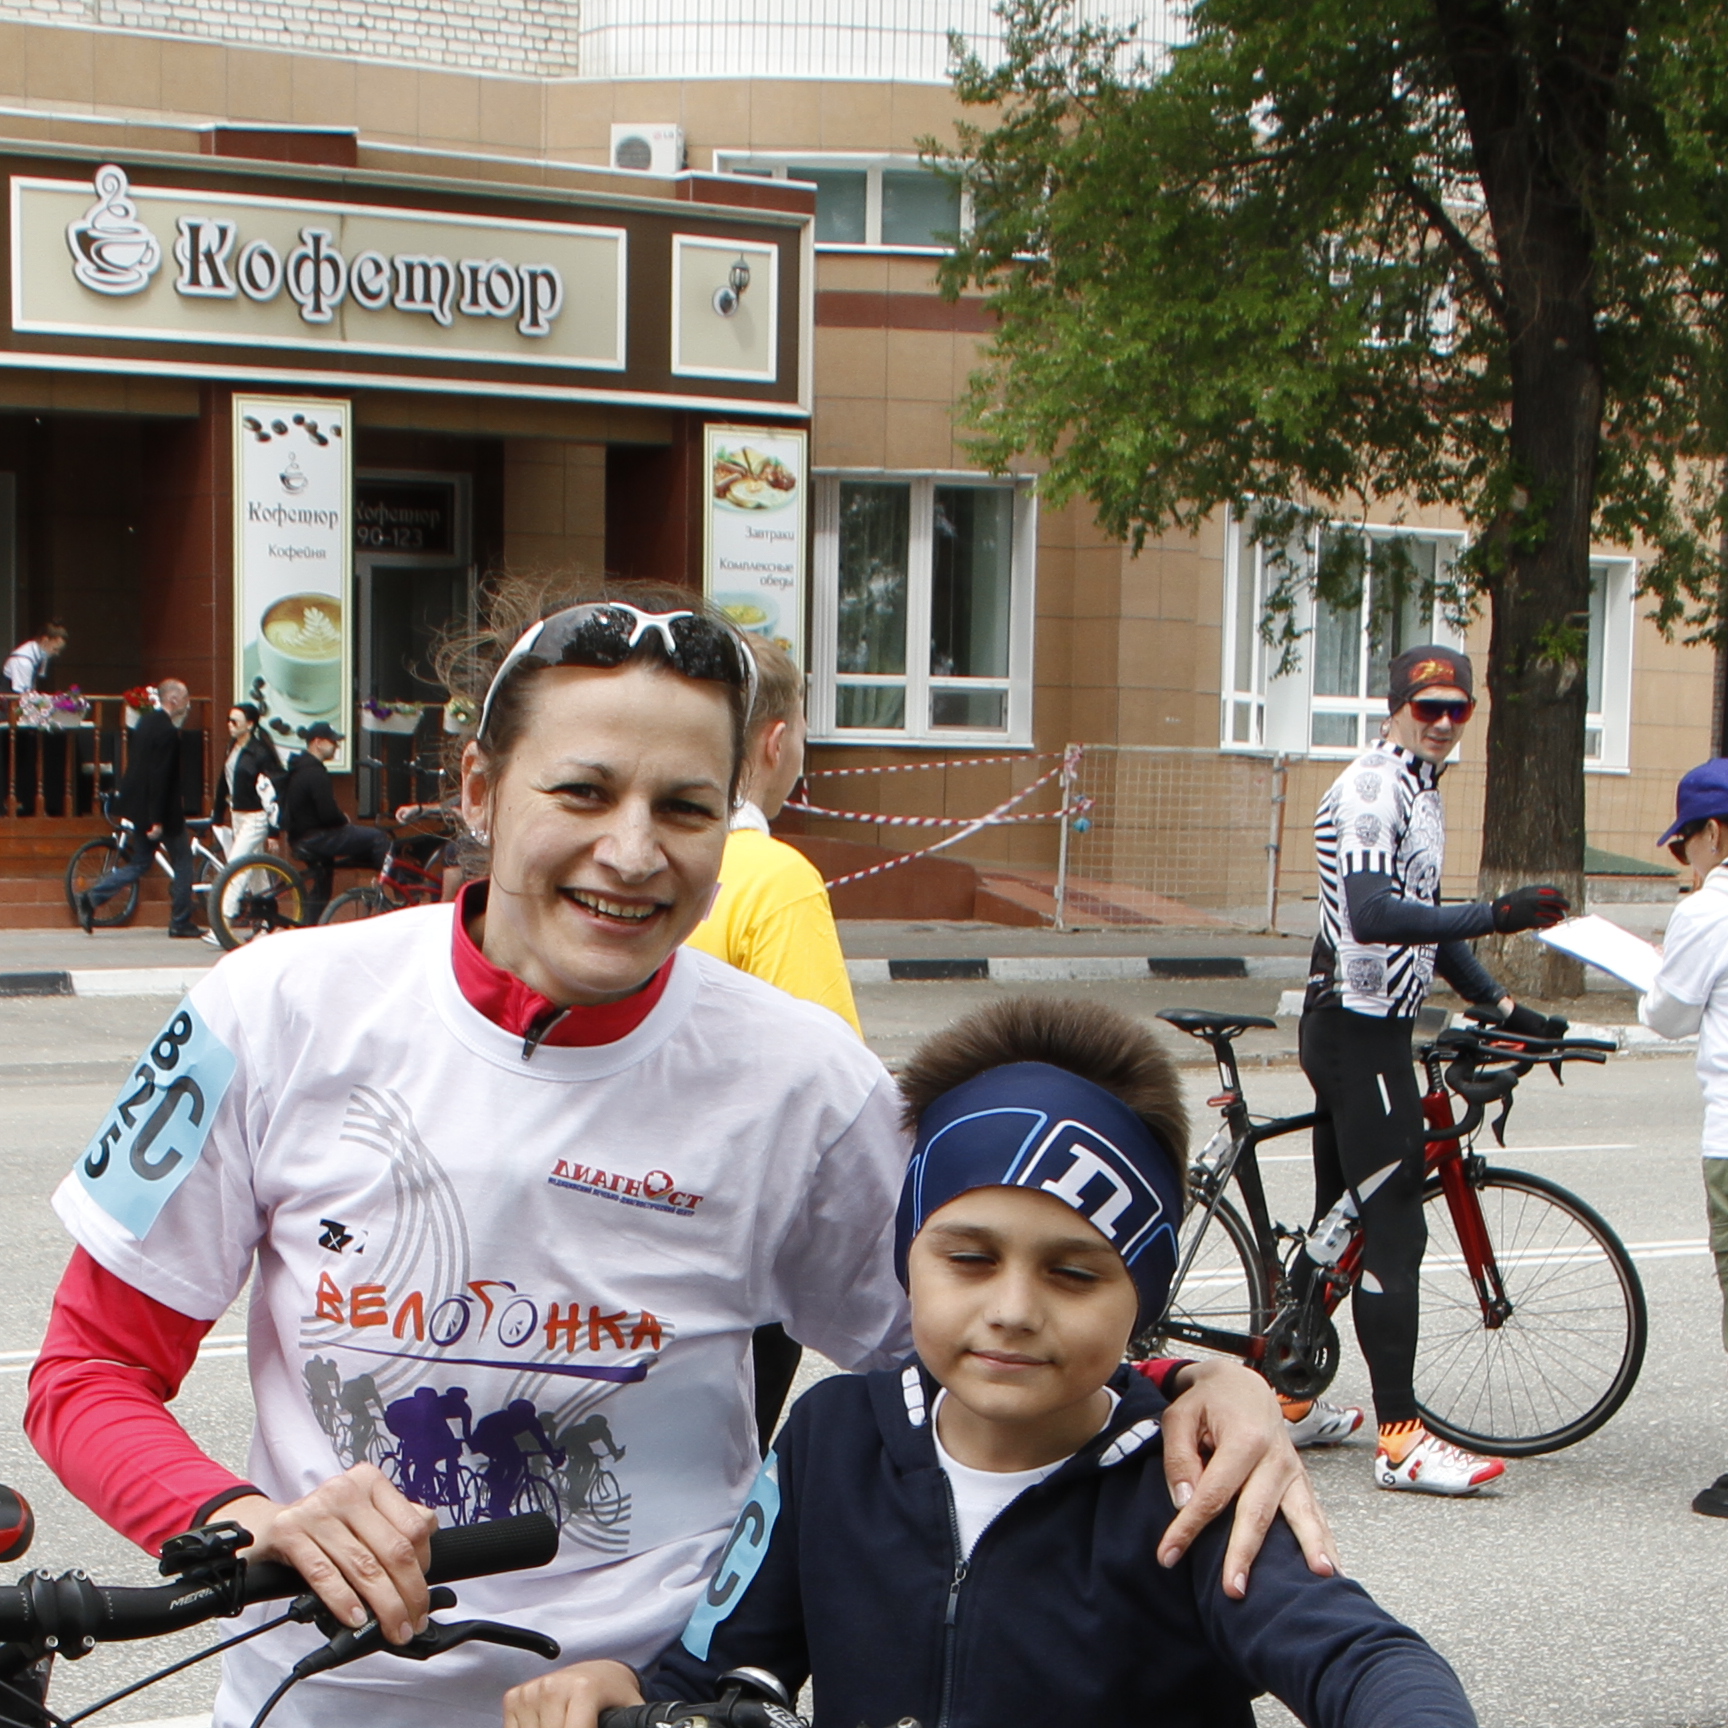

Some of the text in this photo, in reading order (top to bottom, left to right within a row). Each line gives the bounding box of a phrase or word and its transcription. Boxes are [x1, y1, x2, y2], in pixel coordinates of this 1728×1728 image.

[174, 214, 564, 337] Кофетюр
[745, 526, 795, 543] Завтраки
[268, 544, 327, 562] Кофейня
[719, 557, 794, 573] Комплексные
[759, 574, 794, 591] обеды
[550, 1158, 704, 1209] ДИАГНОСТ
[315, 1271, 663, 1353] ВЕЛОГОНКА
